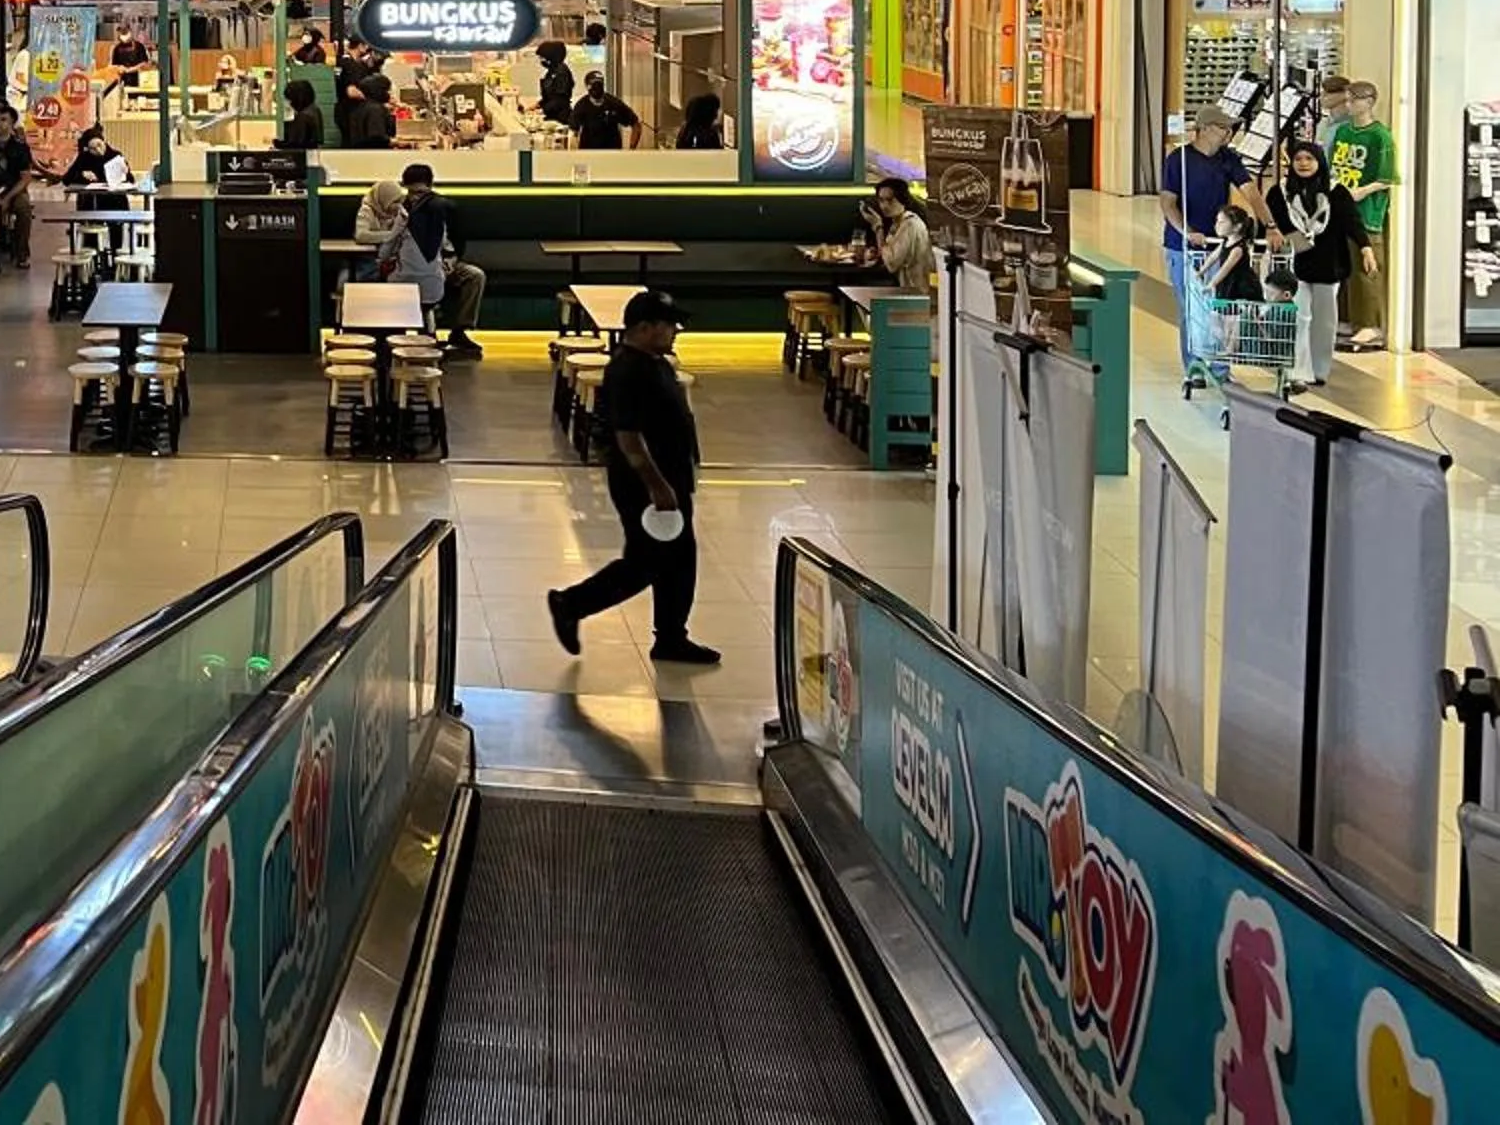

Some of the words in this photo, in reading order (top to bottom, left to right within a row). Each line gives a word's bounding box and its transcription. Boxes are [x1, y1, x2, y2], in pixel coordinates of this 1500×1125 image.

[379, 1, 517, 25] BUNGKUS
[931, 126, 987, 139] BUNGKUS
[260, 214, 295, 228] TRASH
